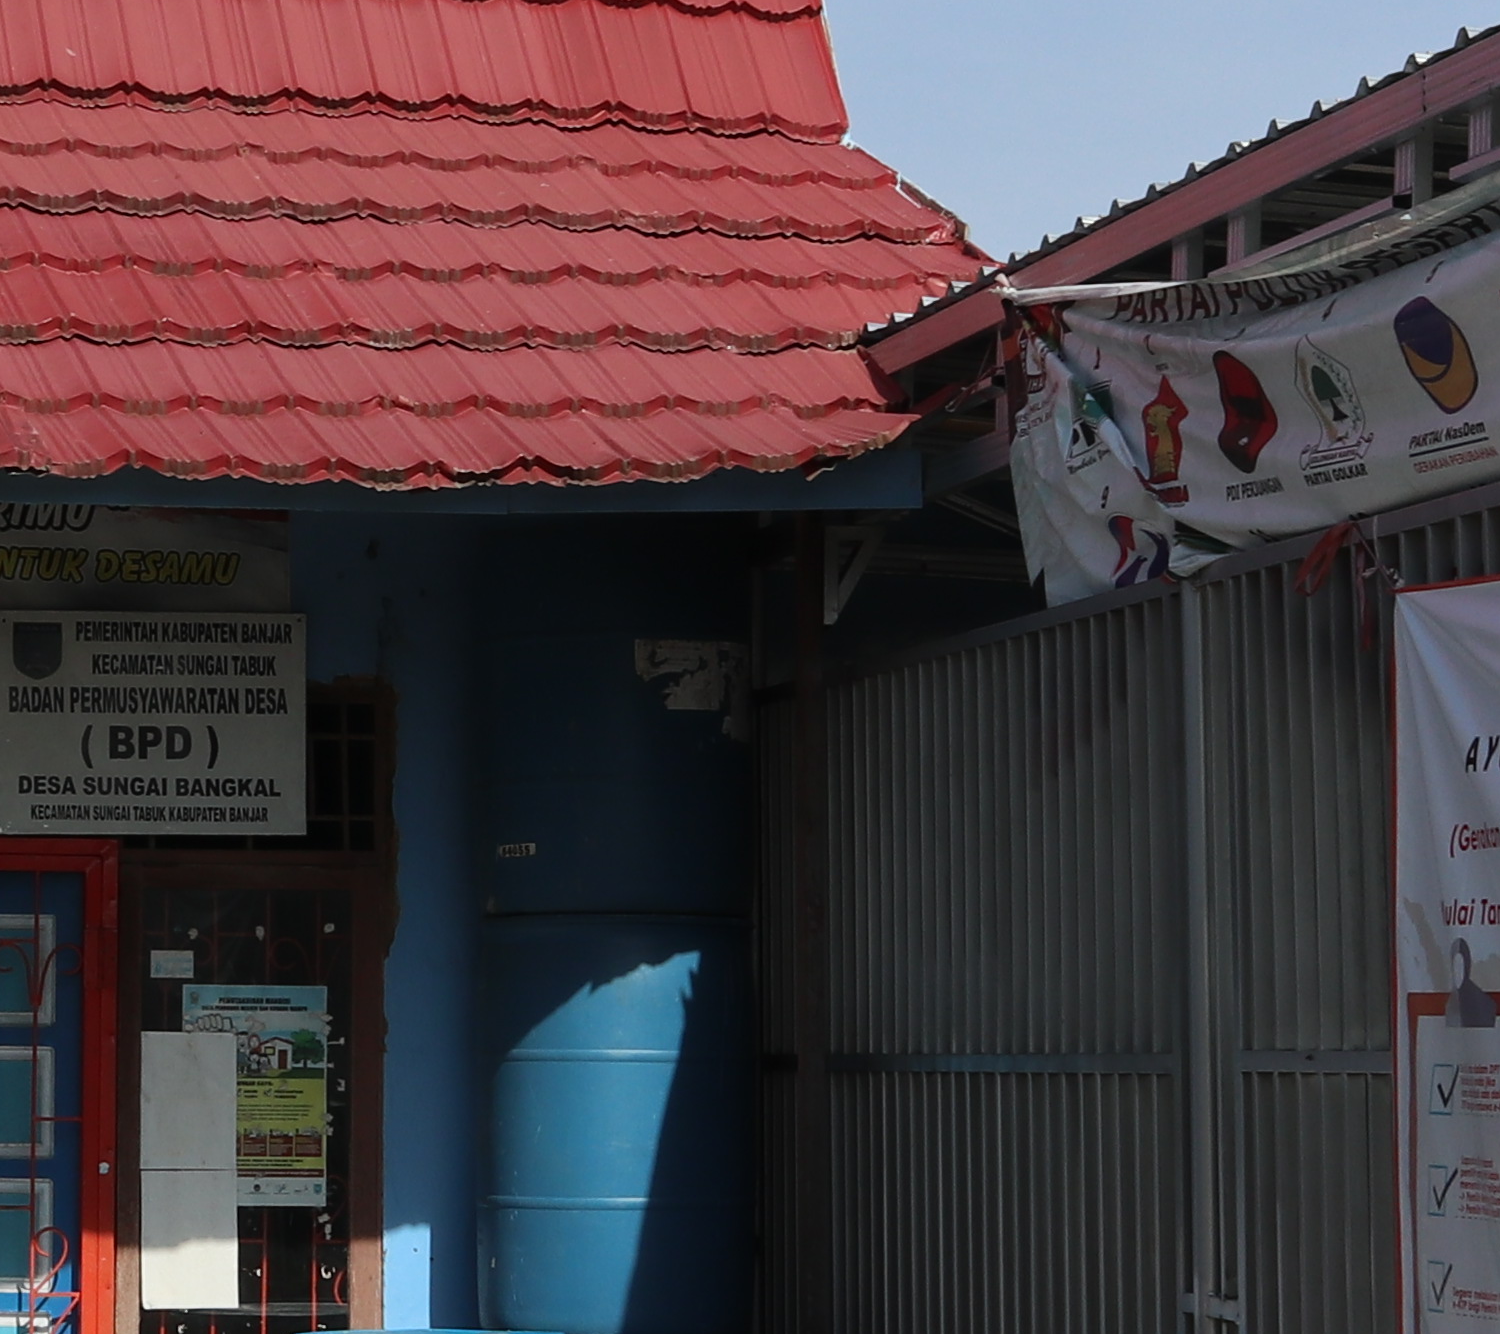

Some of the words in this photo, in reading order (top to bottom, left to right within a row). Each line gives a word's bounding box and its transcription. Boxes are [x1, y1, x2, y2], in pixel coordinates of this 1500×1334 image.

[1408, 430, 1443, 450] PARTAI
[1445, 421, 1486, 443] NasDem
[1304, 472, 1332, 486] PARTAI
[1332, 463, 1368, 482] GOLKAR
[1226, 484, 1239, 501] PDI
[1241, 476, 1284, 499] PERJUANGAN
[95, 548, 241, 586] DESAMU
[76, 621, 158, 642] PEMERINTAH
[162, 622, 237, 643] KABUPATEN
[241, 623, 292, 644] BANJAR
[92, 654, 174, 675] KECAMATAN
[178, 655, 228, 676] SUNGAI
[231, 656, 276, 676] TABUK
[9, 686, 64, 713] BADAN
[70, 687, 239, 714] PERMUSYAWARATAN
[245, 688, 288, 715] DESA
[109, 725, 192, 759] BPD
[18, 775, 76, 795] DESA
[83, 776, 167, 796] SUNGAI
[175, 778, 281, 797] BANGKAL
